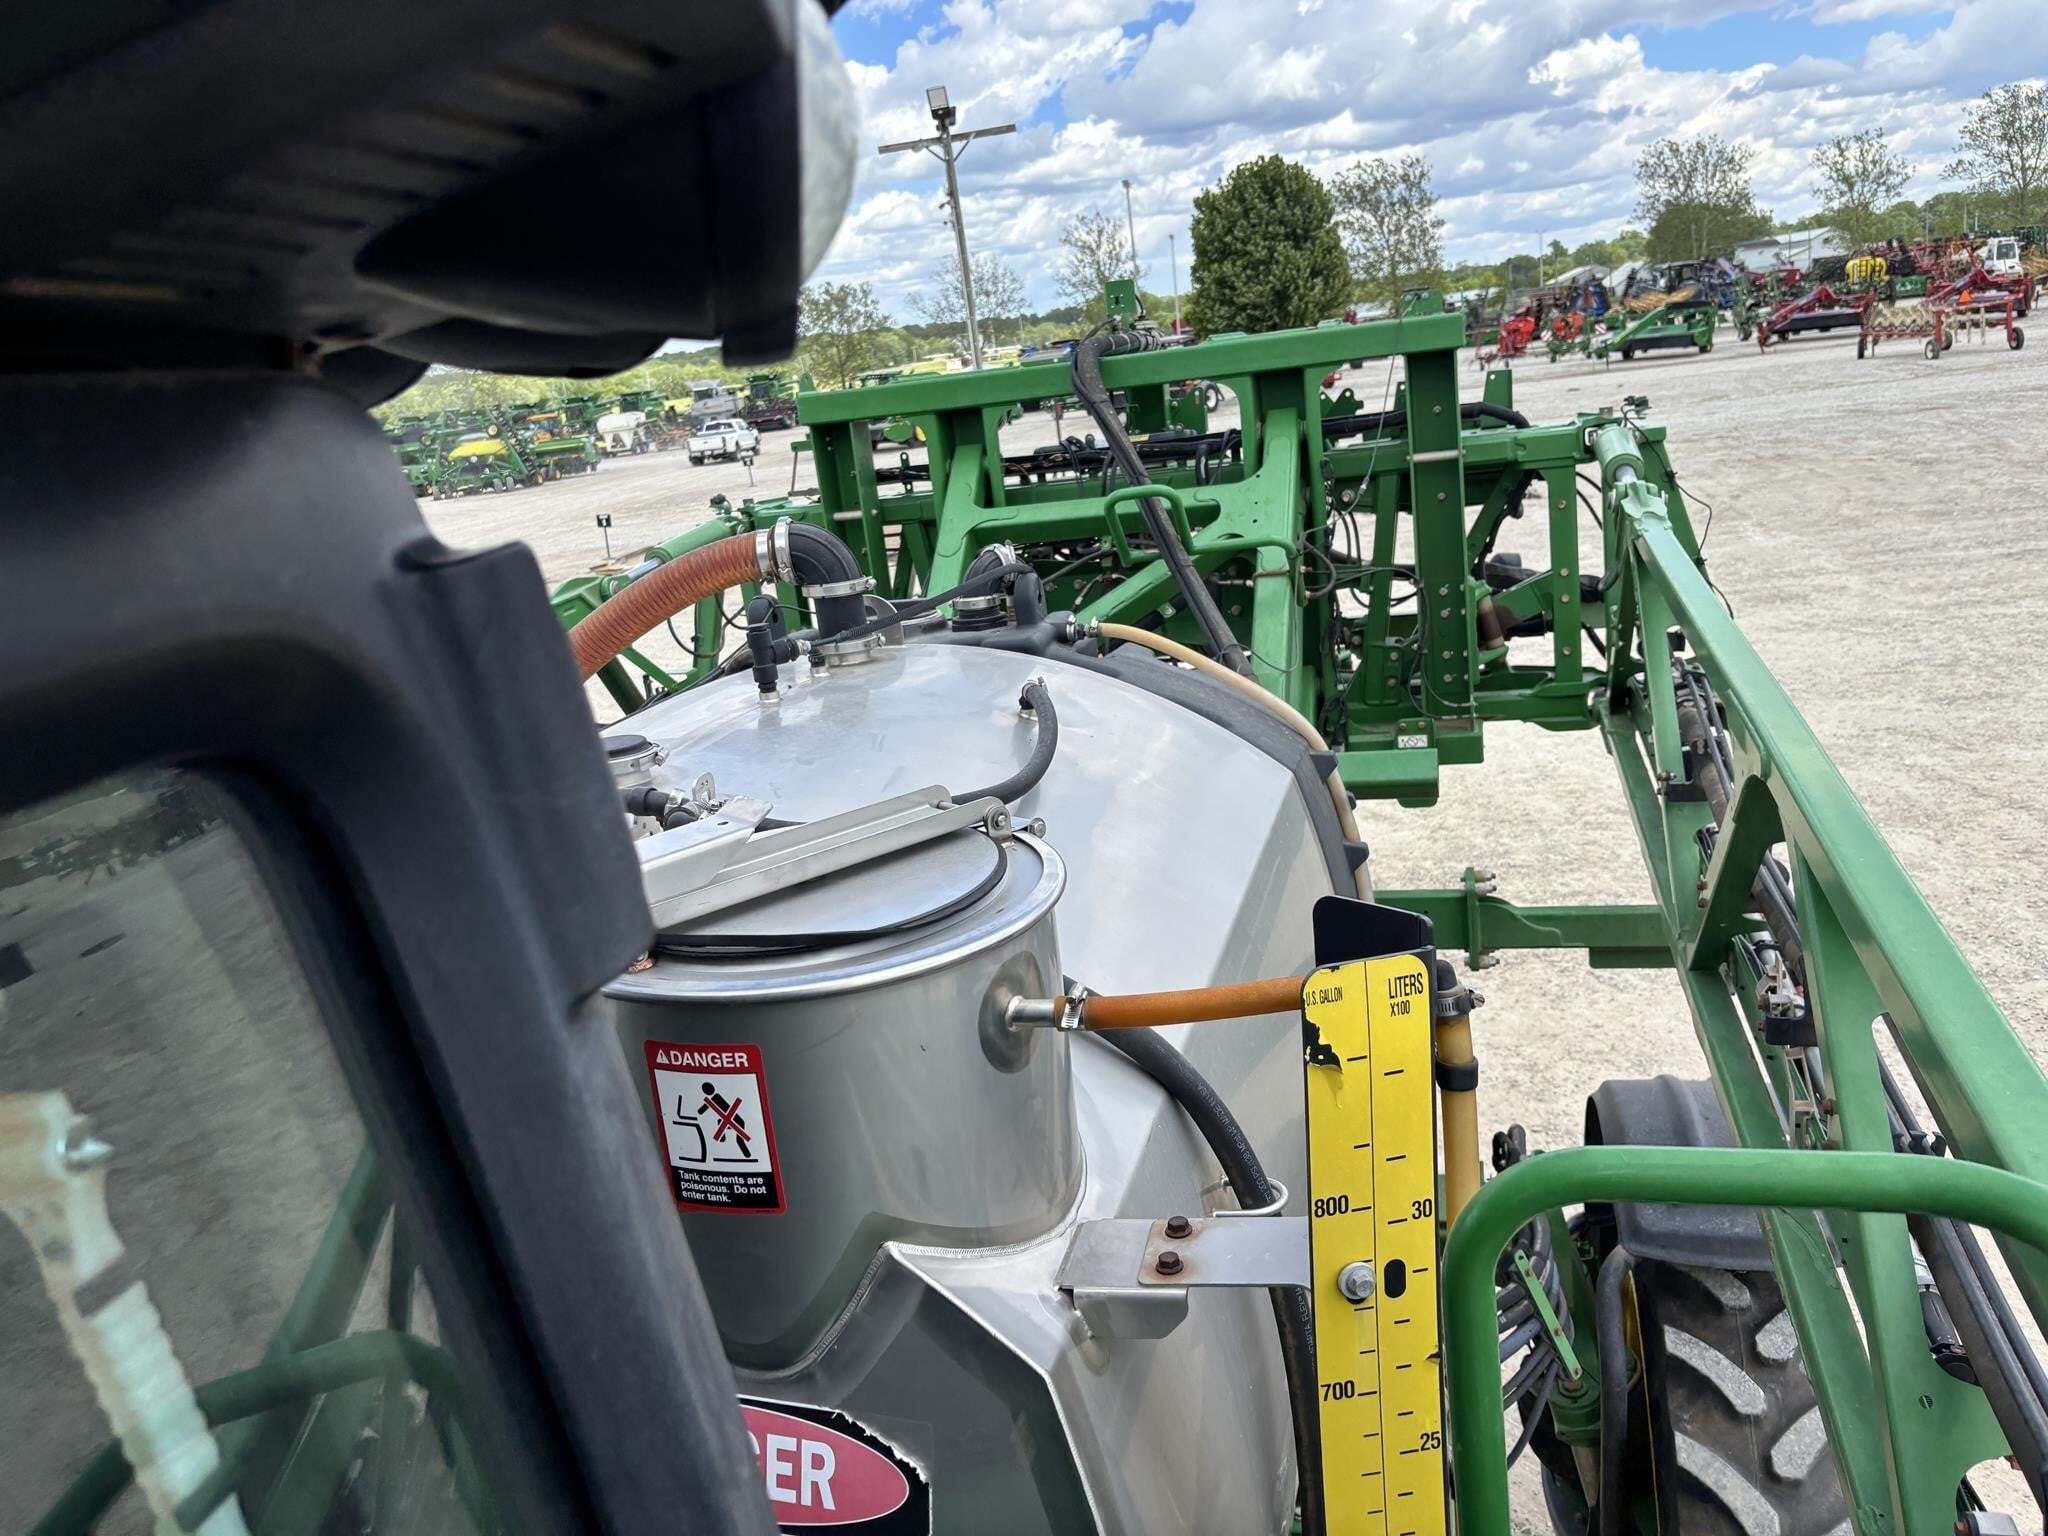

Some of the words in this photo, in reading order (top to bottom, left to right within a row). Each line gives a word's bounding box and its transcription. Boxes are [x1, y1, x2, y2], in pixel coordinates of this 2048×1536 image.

[1388, 972, 1424, 999] LITERS
[1305, 991, 1317, 1006] U.S.
[1319, 986, 1343, 1005] GALLON
[1390, 1000, 1411, 1017] X100
[670, 1051, 749, 1068] DANGER
[678, 1170, 701, 1181] Tank
[702, 1174, 745, 1185] contents
[747, 1176, 764, 1184] are
[681, 1181, 730, 1193] poisonous.
[734, 1184, 749, 1194] Do
[750, 1185, 767, 1194] not
[682, 1190, 705, 1200] enter
[707, 1192, 731, 1203] tank.
[1314, 1195, 1349, 1218] 800
[1411, 1198, 1433, 1220] 30
[1320, 1380, 1355, 1402] 700
[1419, 1431, 1441, 1452] 25
[748, 1431, 836, 1511] ER
